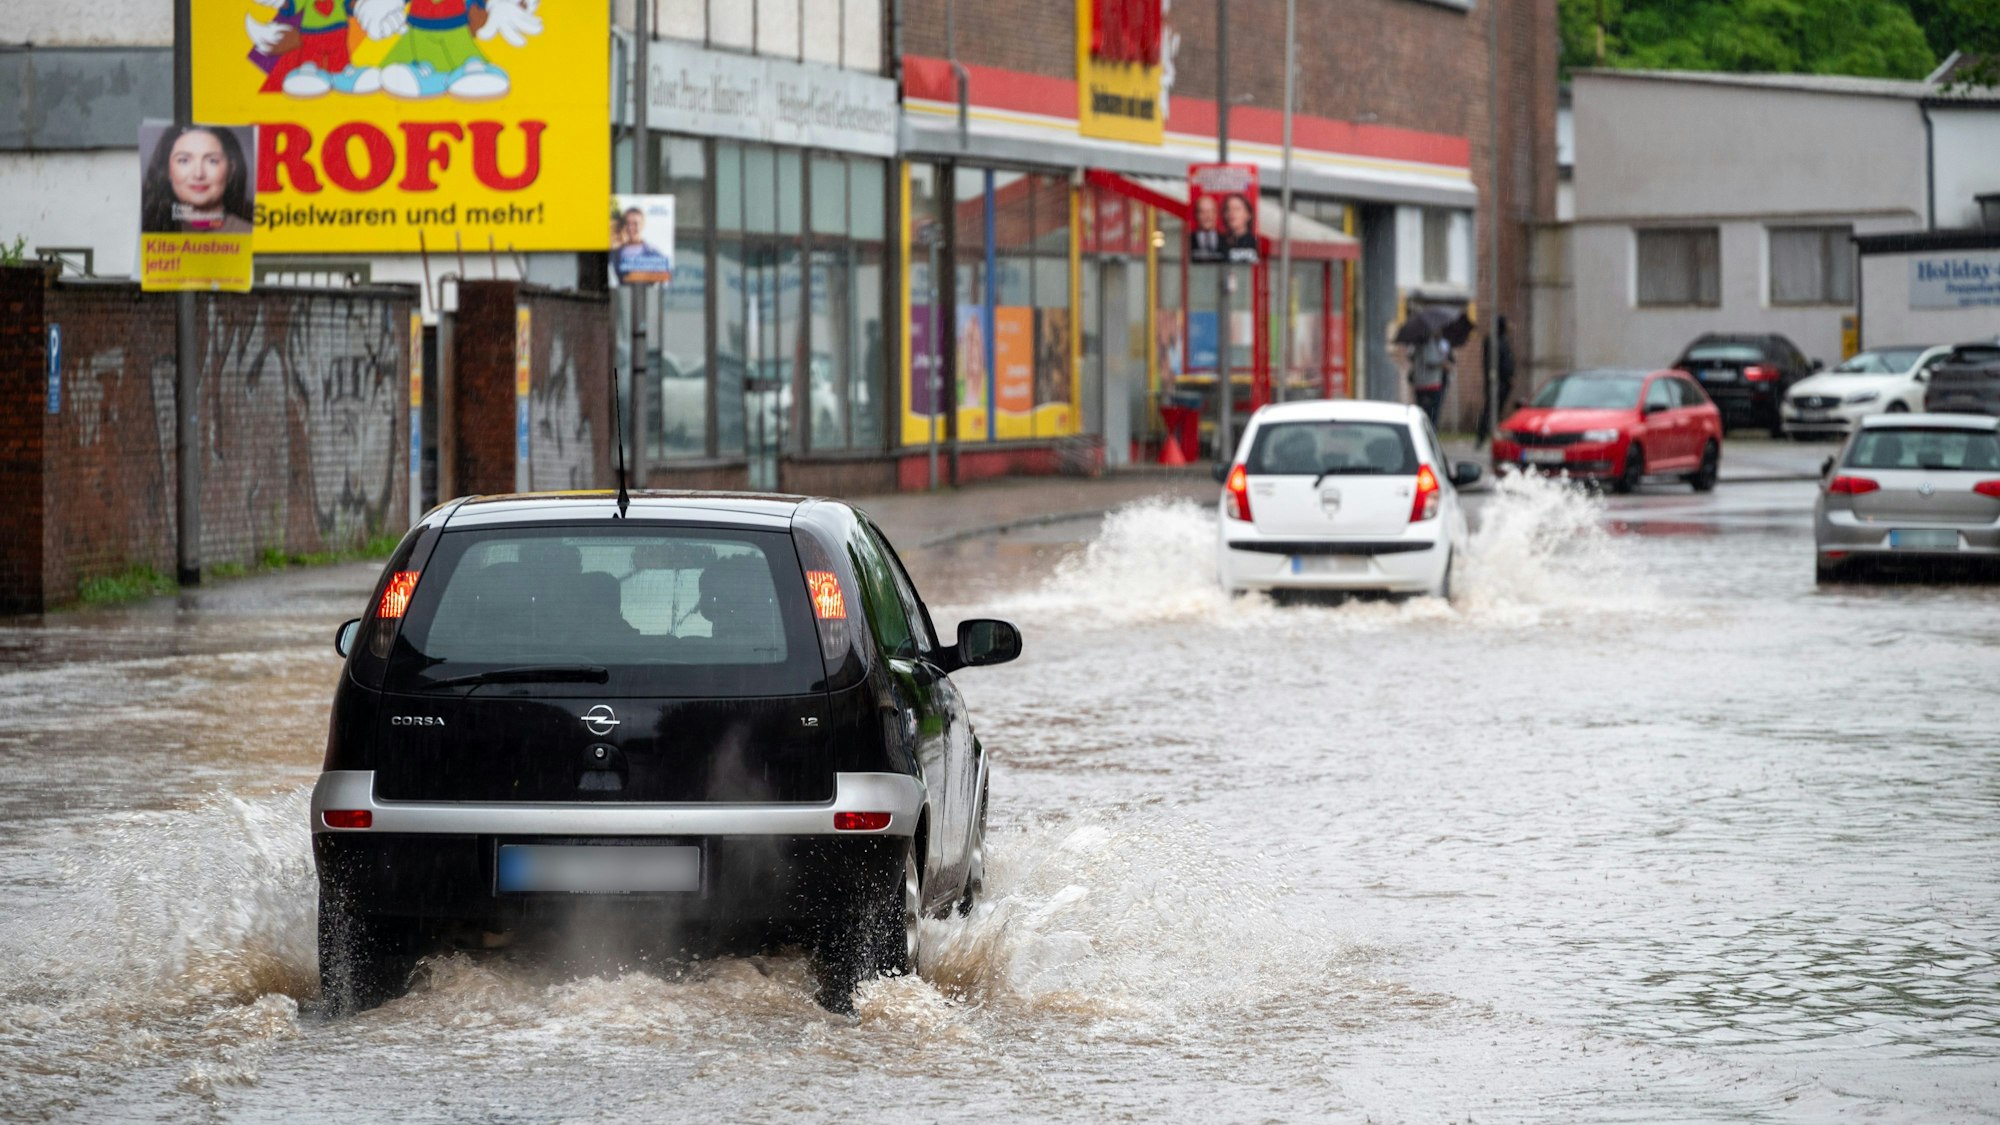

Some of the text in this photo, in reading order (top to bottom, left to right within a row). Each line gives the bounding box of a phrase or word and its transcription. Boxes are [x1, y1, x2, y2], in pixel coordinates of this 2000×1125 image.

[256, 120, 547, 195] ROFU
[252, 202, 397, 230] Spielwaren
[407, 203, 456, 225] und
[466, 201, 544, 225] mehr!
[146, 239, 241, 255] Kita-Ausbau
[146, 257, 181, 275] jetzt!
[391, 715, 446, 726] CORSA
[800, 716, 819, 727] 1.2
